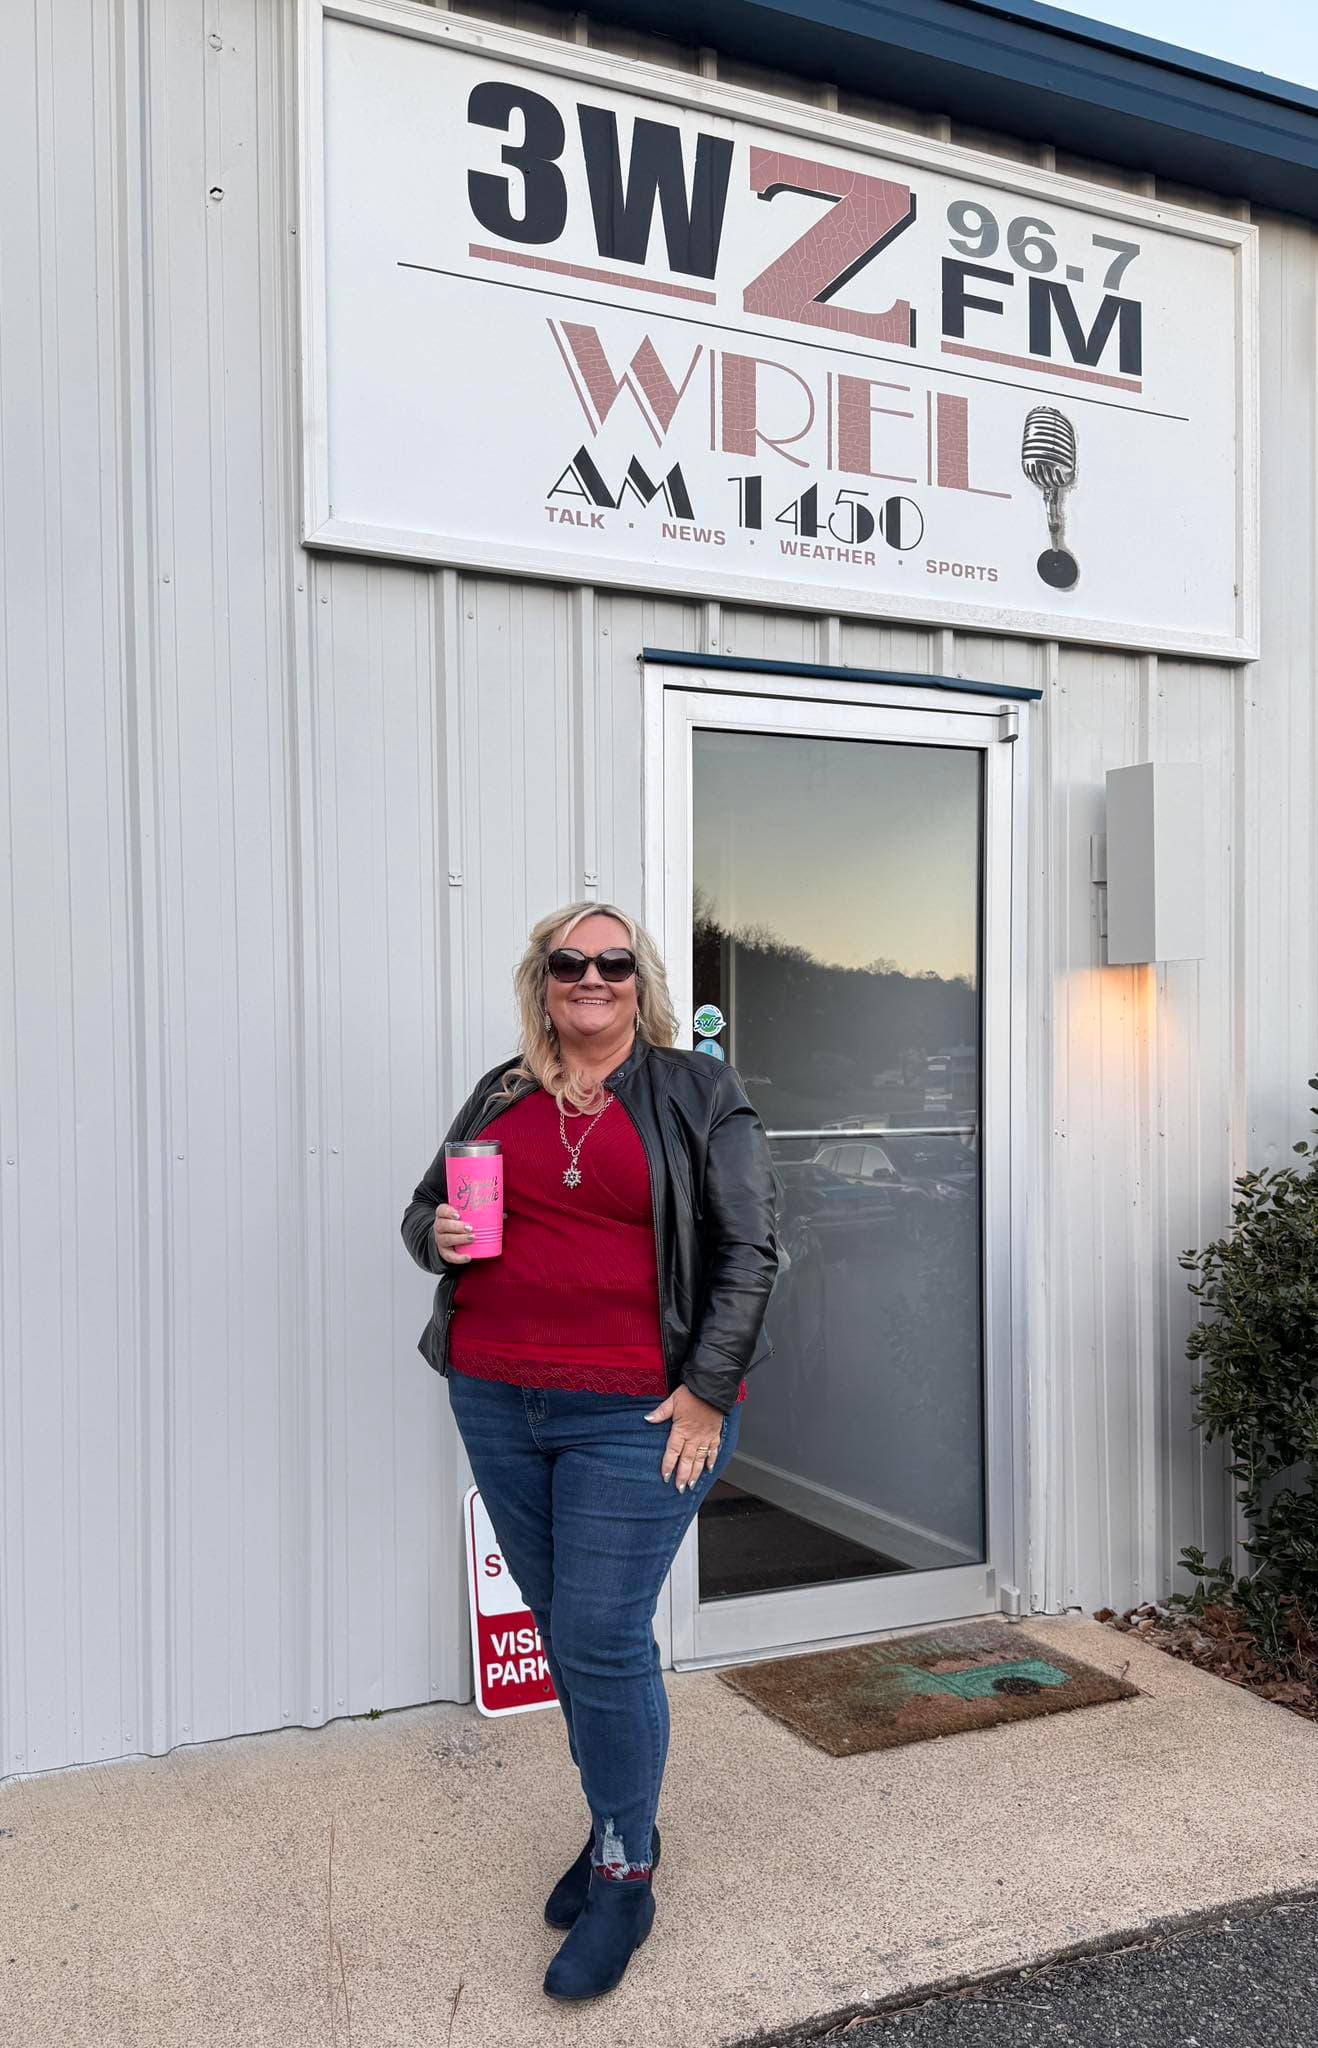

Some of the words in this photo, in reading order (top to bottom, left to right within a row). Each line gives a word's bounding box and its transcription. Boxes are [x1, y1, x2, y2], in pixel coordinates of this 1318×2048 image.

[946, 200, 1141, 291] 96.7
[942, 256, 1142, 376] FM
[546, 317, 1012, 499] WREL
[545, 506, 606, 530] TALK
[661, 522, 726, 546] NEWS
[779, 539, 876, 567] WEATHER
[926, 559, 999, 583] SPORTS
[546, 444, 695, 521] AM
[727, 474, 924, 551] 1450
[694, 1016, 722, 1030] 3WZ
